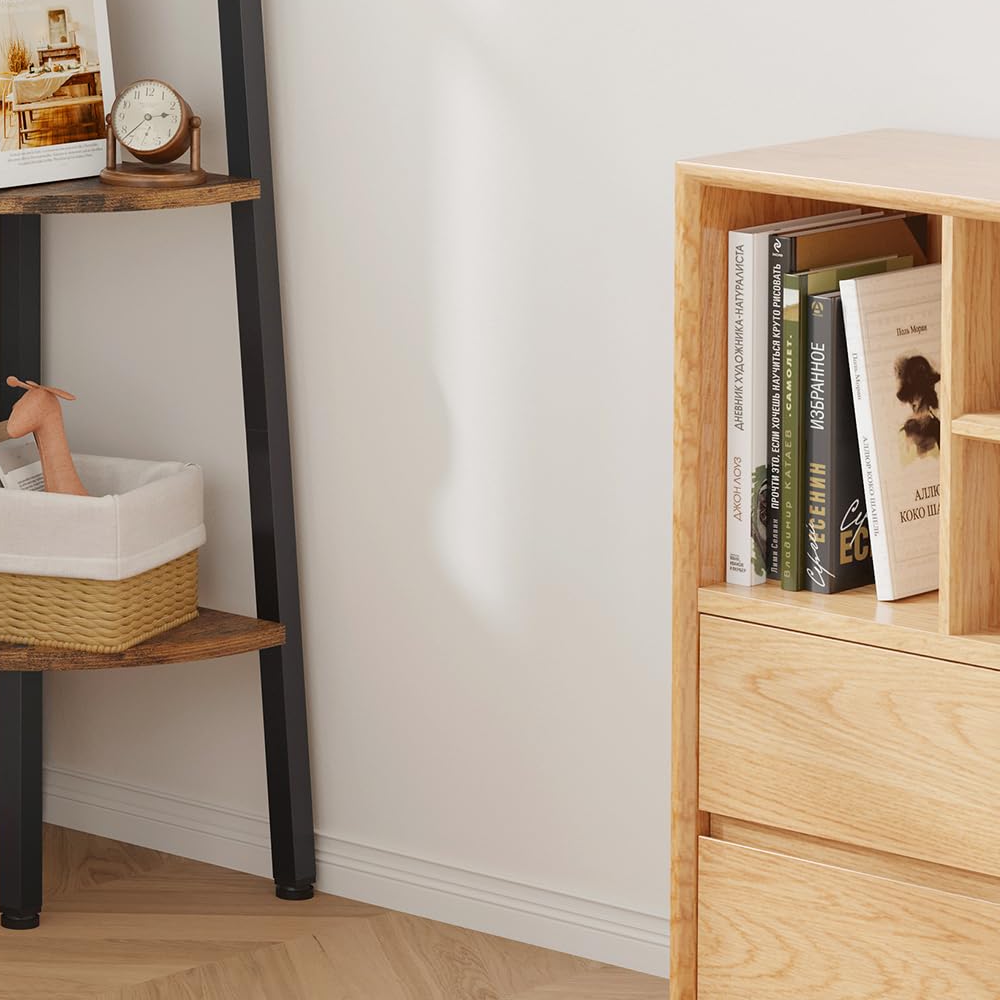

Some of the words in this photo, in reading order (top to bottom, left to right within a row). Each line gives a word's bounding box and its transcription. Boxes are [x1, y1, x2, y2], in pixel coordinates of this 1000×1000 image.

[145, 87, 155, 97] 12
[773, 264, 782, 308] РИСОВАТЬ
[735, 244, 744, 384] ХУДОЖНИКА-НАТУРАЛИСТА
[772, 310, 781, 338] КРУТО
[896, 327, 910, 336] Поль
[910, 324, 928, 334] Моран
[772, 340, 781, 391] НАУЧИТЬСЯ
[810, 342, 825, 430] ИЗБРАННОЕ
[734, 386, 744, 431] ДНЕВНИК
[772, 393, 780, 429] ХОЧЕШЬ
[772, 431, 780, 453] ЕСЛИ
[784, 430, 792, 489] КАТАЕВ
[734, 456, 742, 484] ЛОУЗ
[772, 454, 780, 474] ЭТО,
[733, 486, 743, 521] ДЖОН
[771, 476, 780, 510] ПРОЧТИ
[808, 462, 826, 544] ЕСЕНИН
[863, 436, 871, 468] АЛЛЮР
[870, 498, 879, 537] ШАНЕЛЬ
[900, 507, 925, 523] КОКО
[784, 501, 793, 578] Владимир
